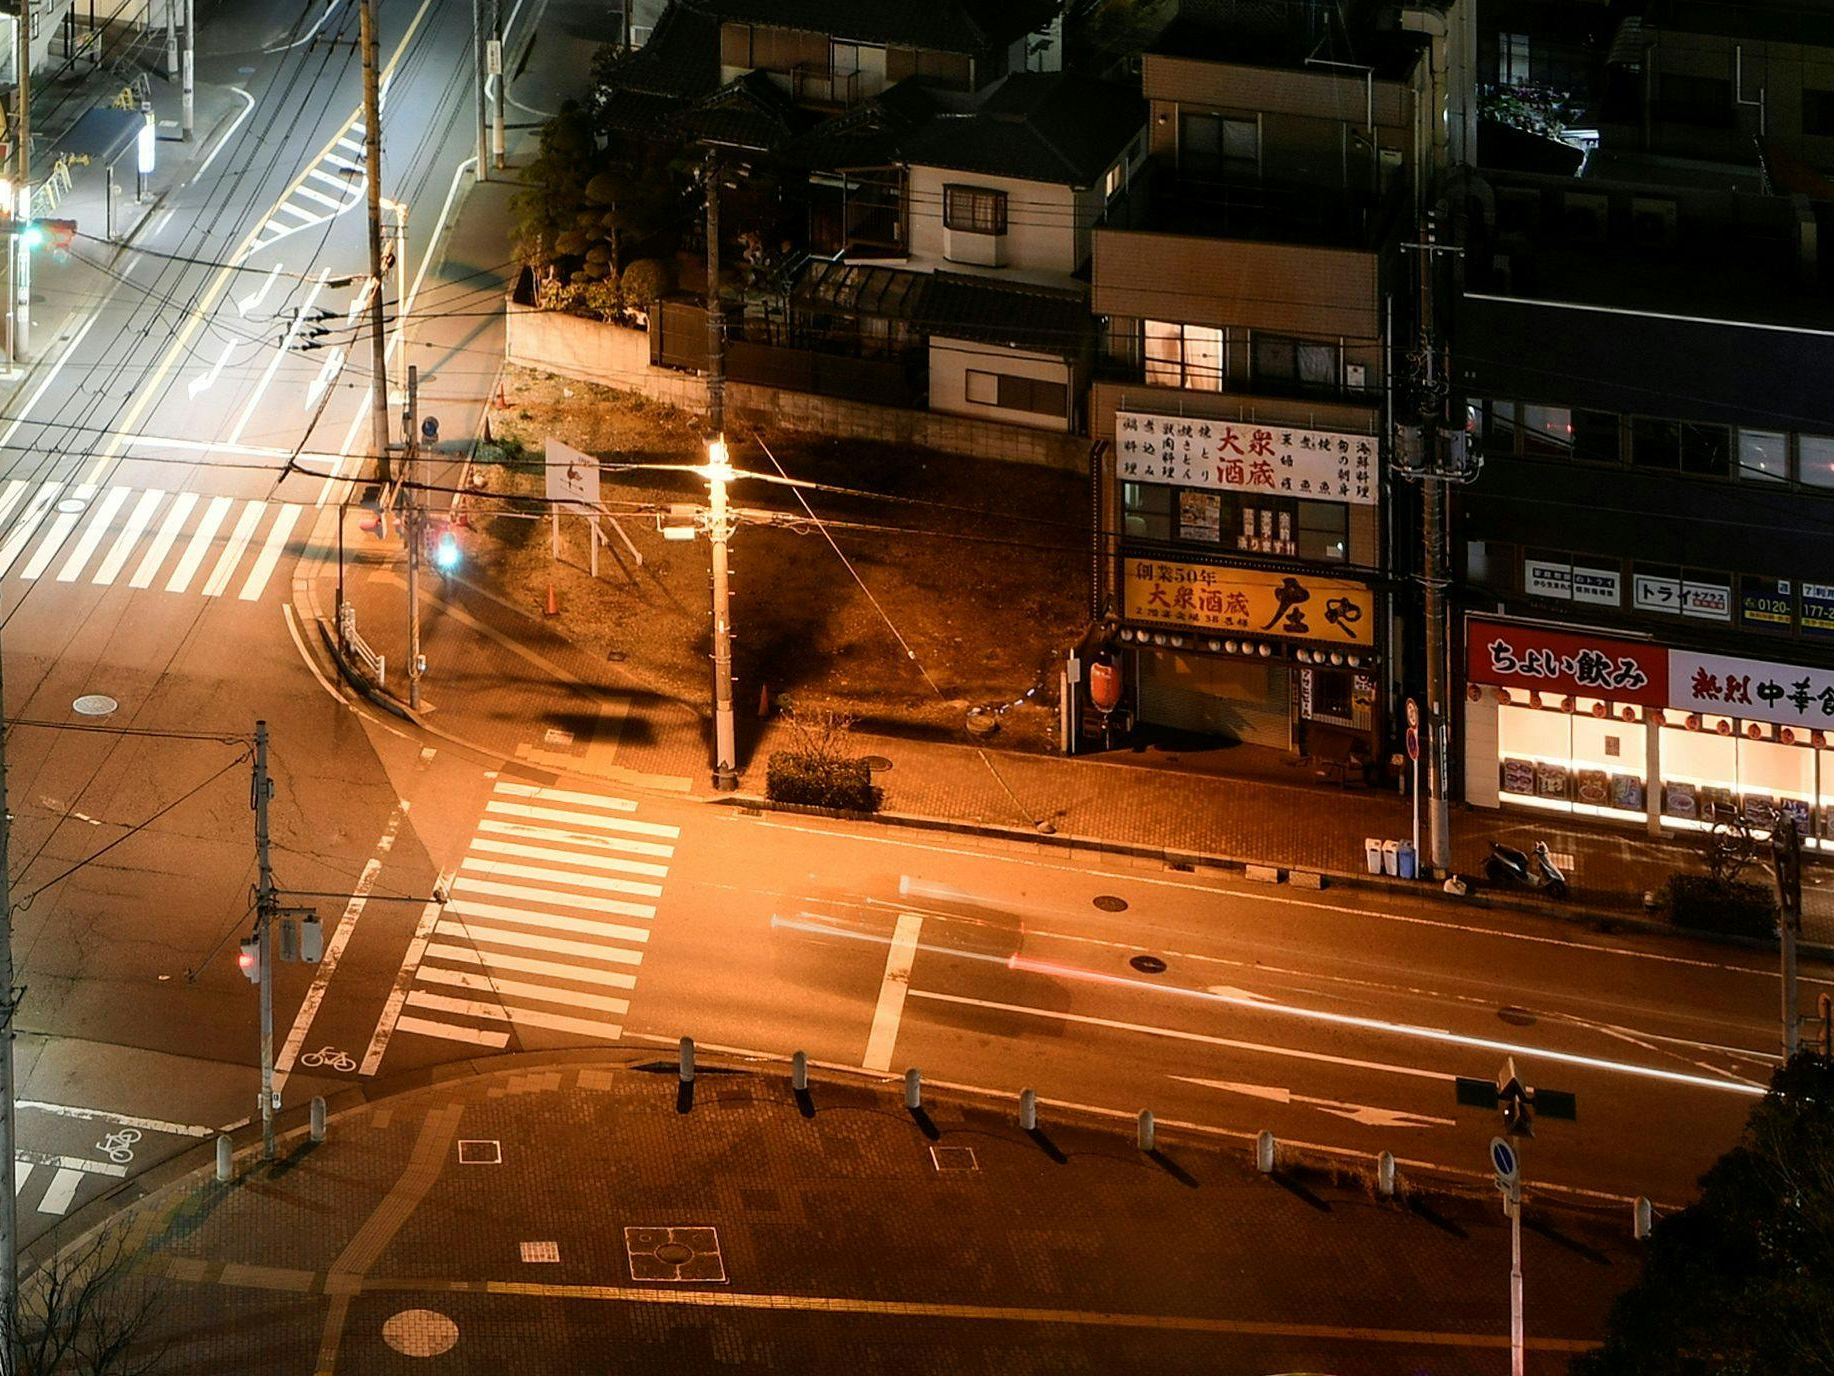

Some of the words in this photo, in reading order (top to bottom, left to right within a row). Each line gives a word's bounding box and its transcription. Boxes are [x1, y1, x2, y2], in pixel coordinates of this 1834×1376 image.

[1136, 562, 1217, 586] 創業50年
[1148, 583, 1250, 618] 大衆酒蔵
[1261, 577, 1363, 639] 庄や
[1487, 638, 1647, 689] ちょい飲み
